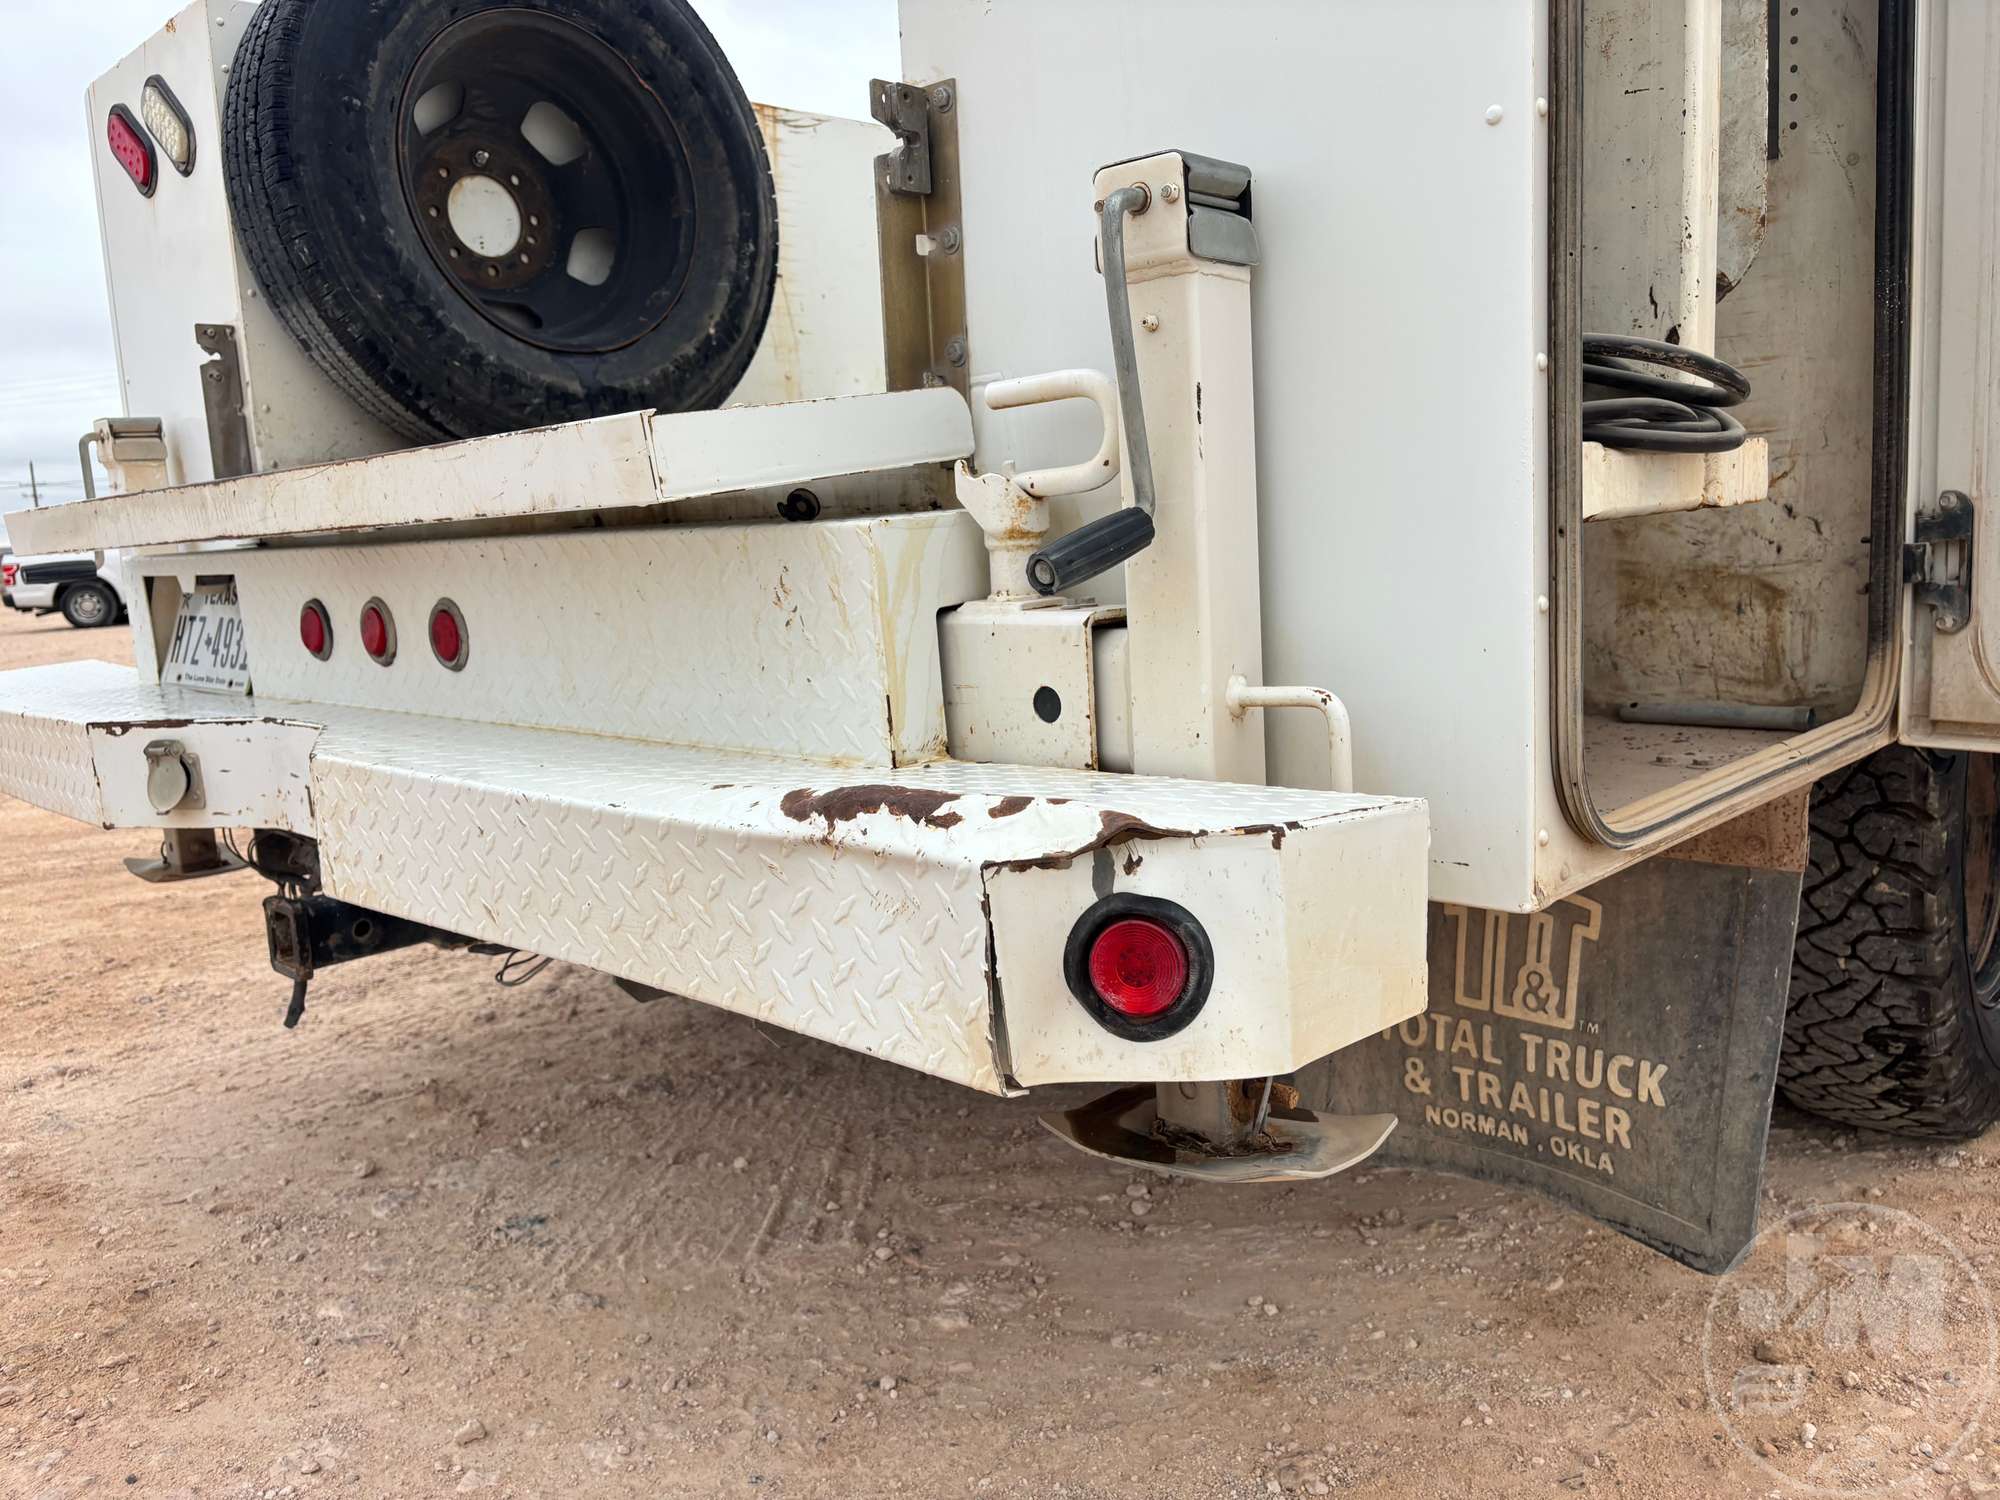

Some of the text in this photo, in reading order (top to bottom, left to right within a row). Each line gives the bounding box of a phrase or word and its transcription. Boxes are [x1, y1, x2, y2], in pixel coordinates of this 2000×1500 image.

[1404, 1056, 1632, 1149] & TRAILER
[1519, 1032, 1668, 1107] TRUCK
[1425, 1104, 1529, 1146] NORMAN
[1550, 1135, 1615, 1175] OKLA
